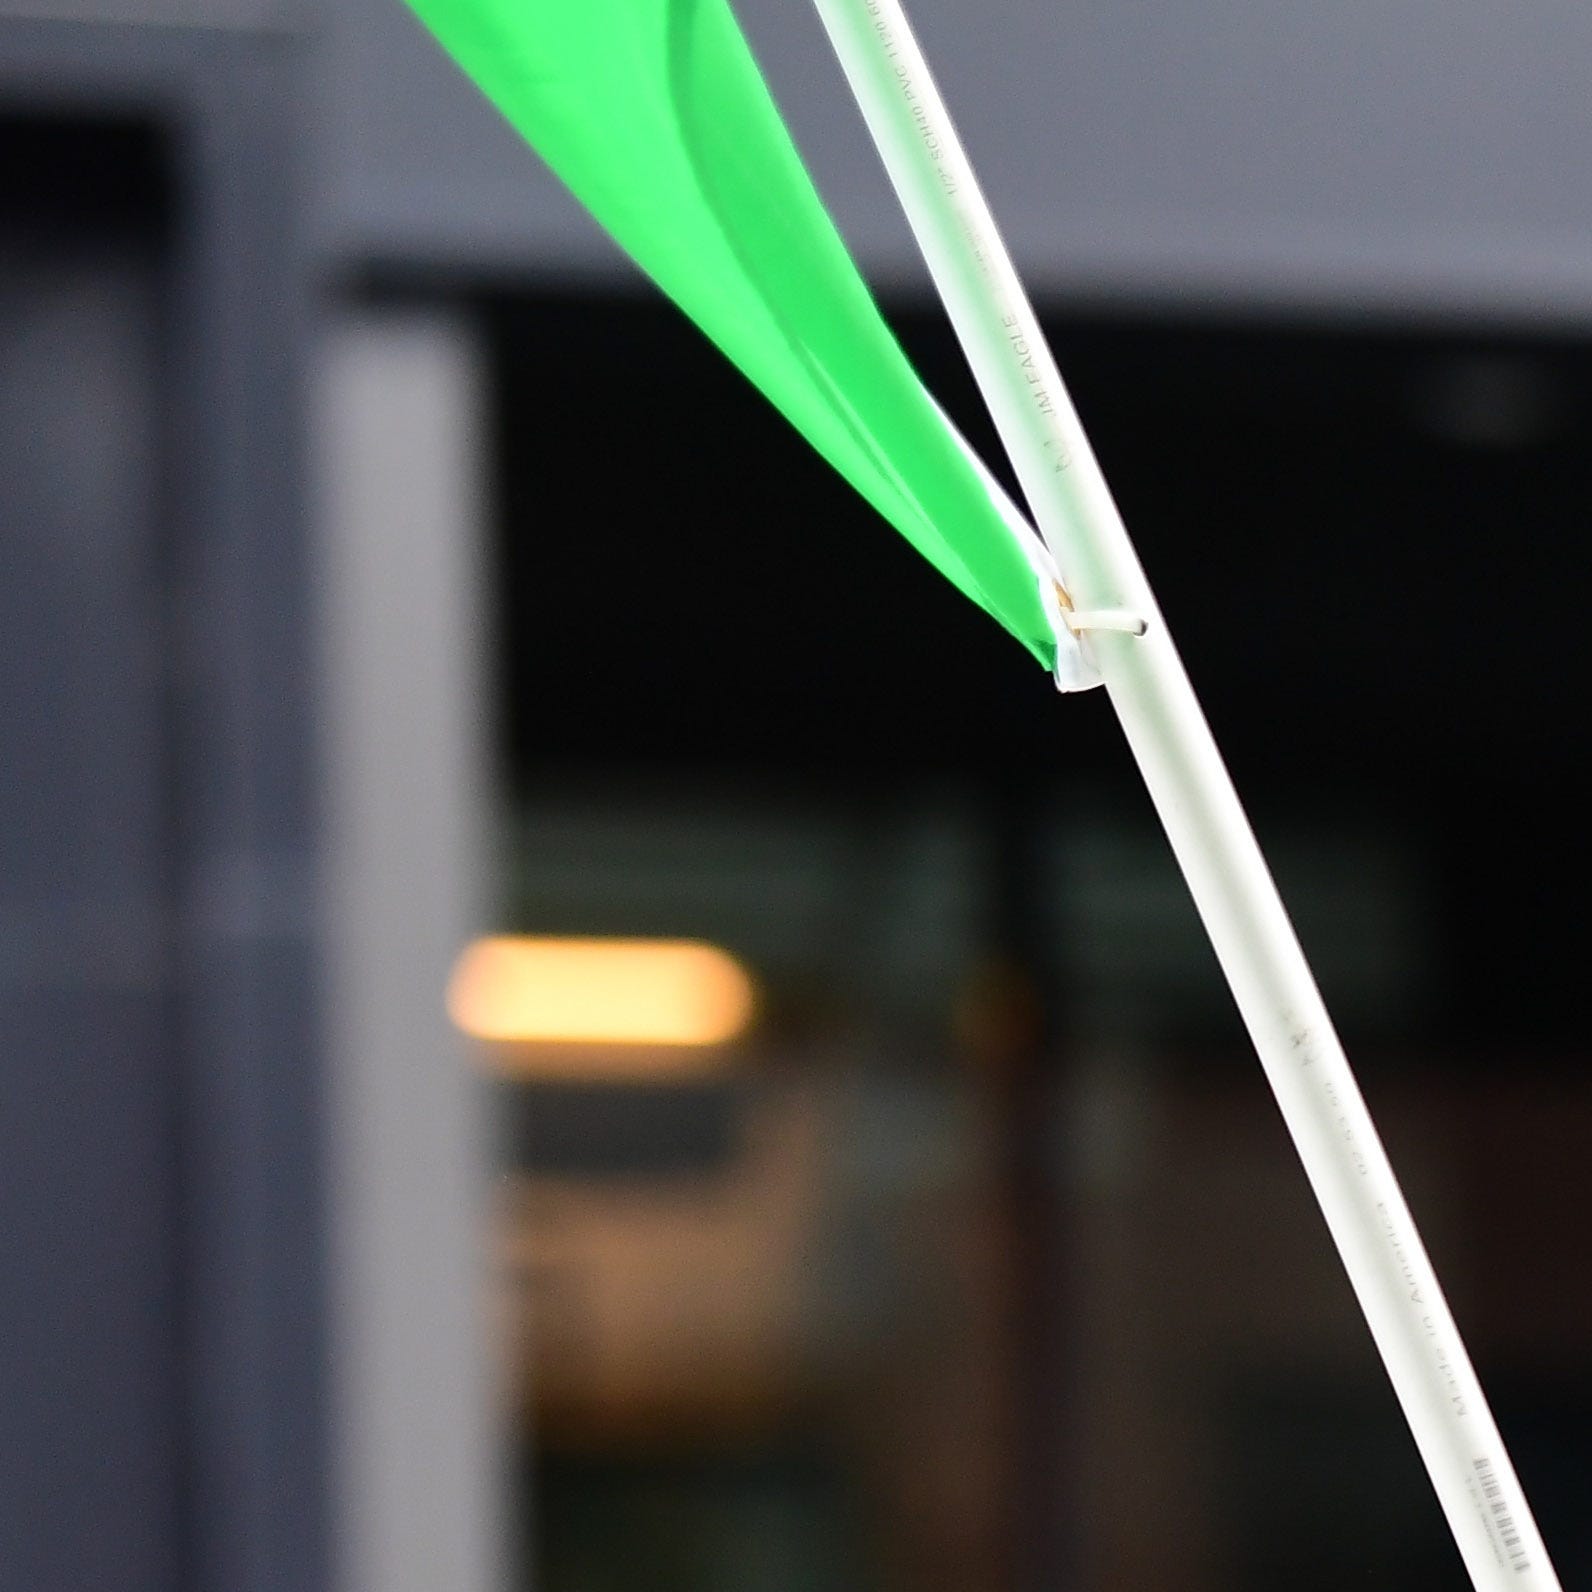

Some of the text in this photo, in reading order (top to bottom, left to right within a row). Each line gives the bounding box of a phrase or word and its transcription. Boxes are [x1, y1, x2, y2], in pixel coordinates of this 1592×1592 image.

[894, 65, 916, 99] PVC
[1002, 312, 1040, 384] EAGLE
[1374, 1202, 1421, 1305] America
